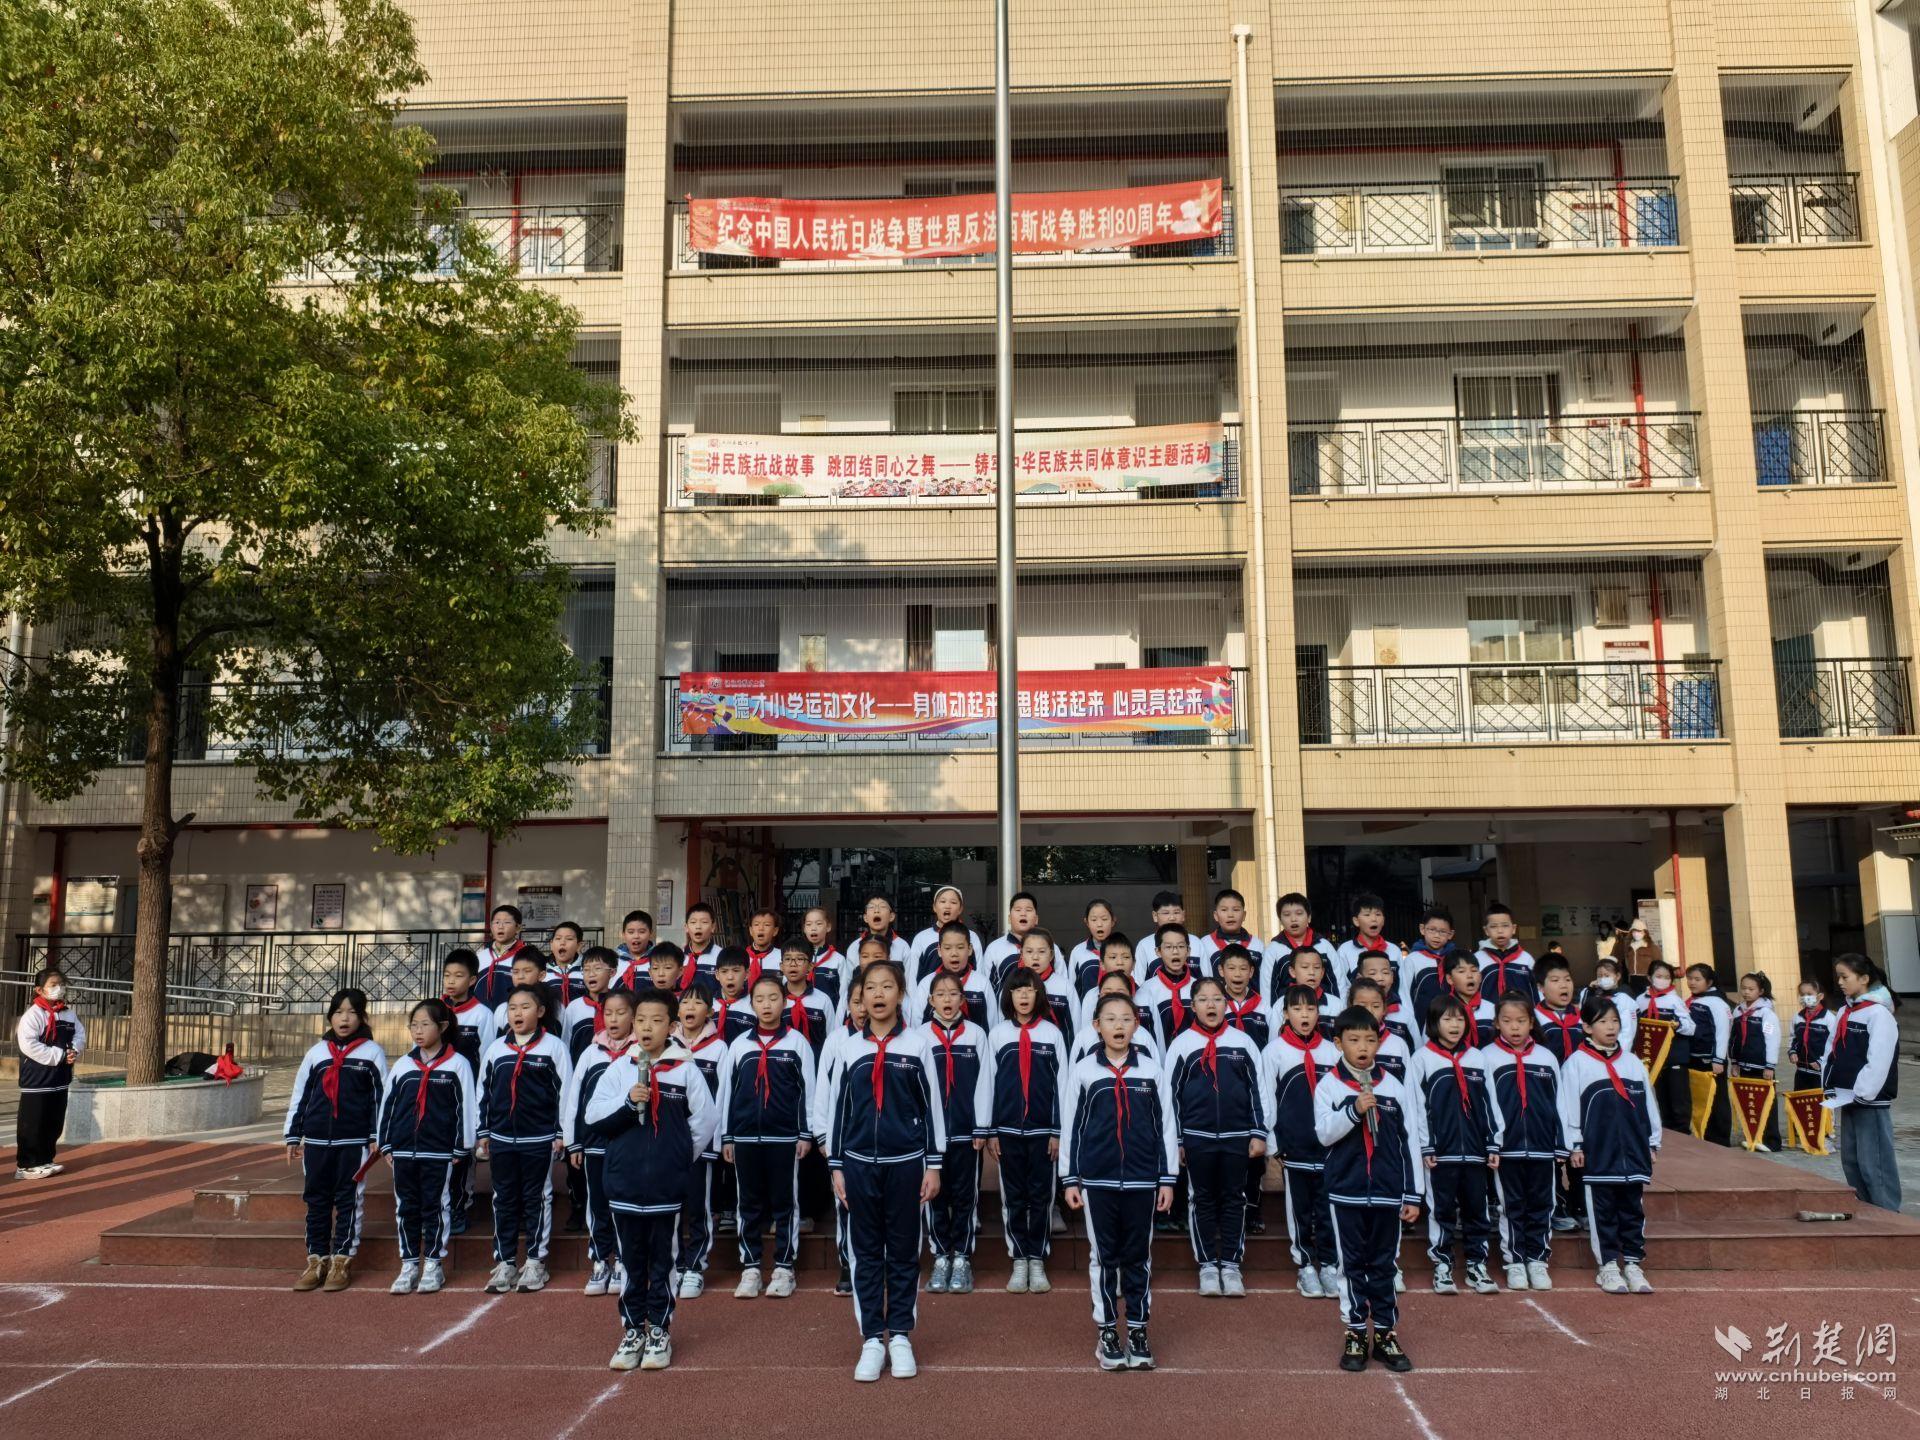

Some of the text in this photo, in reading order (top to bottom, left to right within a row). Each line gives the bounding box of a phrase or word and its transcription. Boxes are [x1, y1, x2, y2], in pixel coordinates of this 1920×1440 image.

[706, 452, 815, 477] 讲民族抗战故事
[1113, 688, 1204, 716] 心灵亮起来
